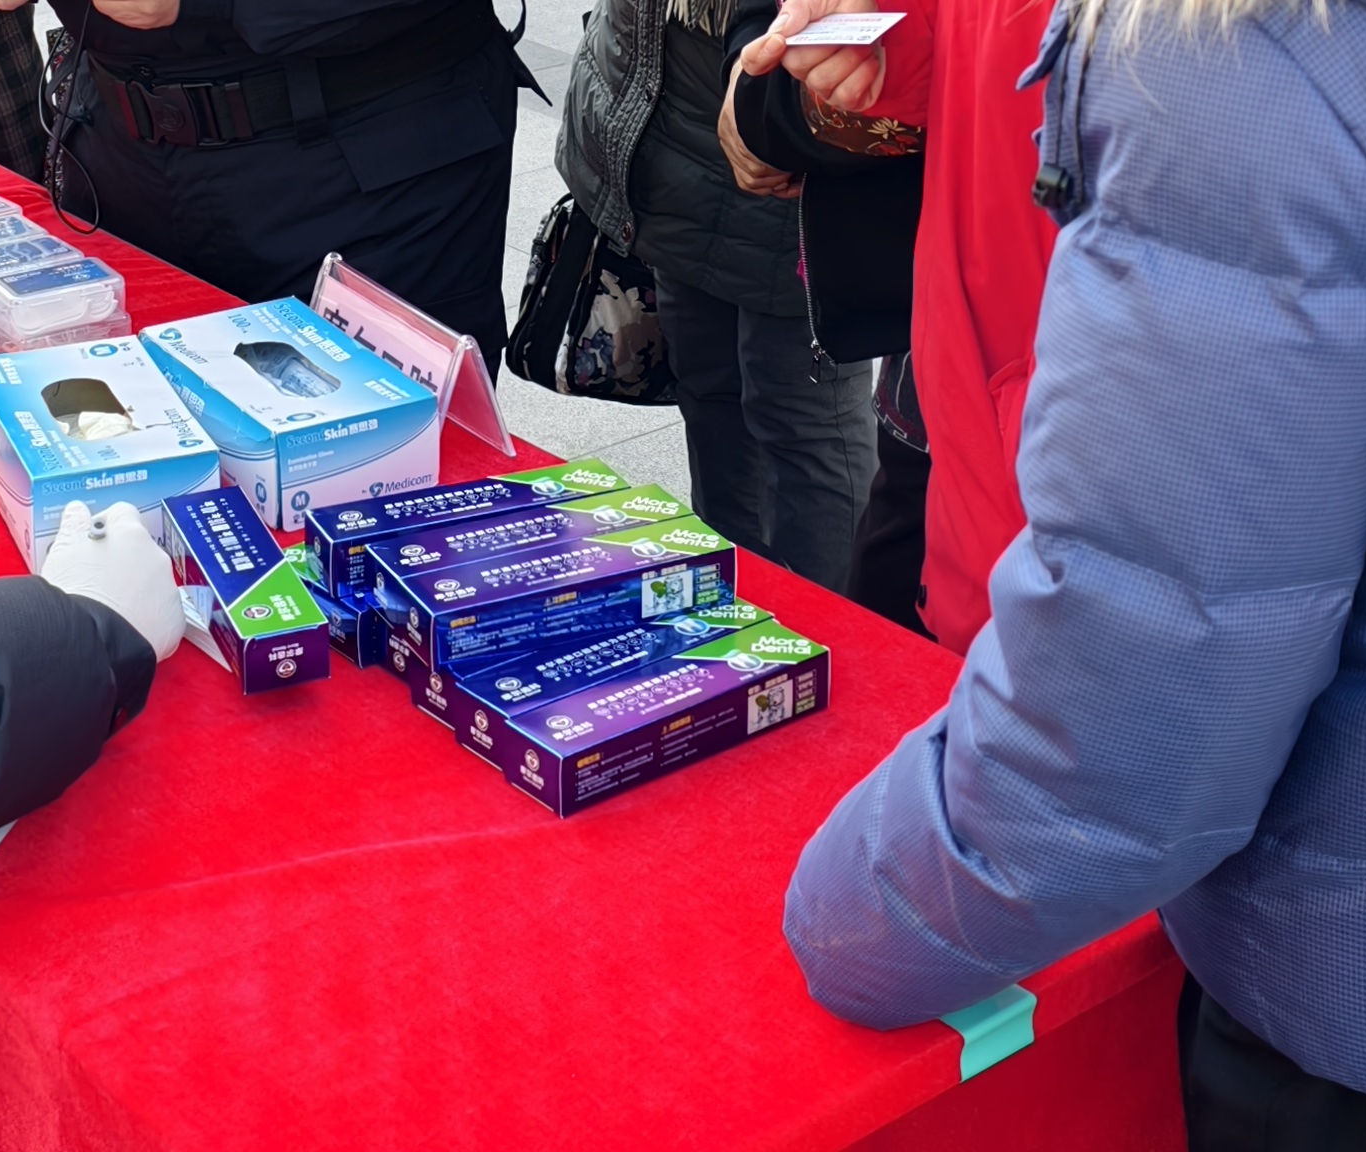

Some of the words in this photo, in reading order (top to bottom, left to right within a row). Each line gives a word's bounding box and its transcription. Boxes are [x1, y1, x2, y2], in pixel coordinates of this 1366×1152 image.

[286, 422, 348, 448] SecondSkin
[561, 473, 617, 488] Dental
[572, 468, 619, 481] More
[42, 472, 113, 496] SecondSkin
[386, 475, 432, 494] Medicom
[295, 493, 306, 508] M
[633, 496, 680, 508] More
[622, 501, 679, 515] Dental
[661, 533, 719, 549] Dental
[671, 528, 719, 540] More
[698, 609, 757, 620] Dental
[758, 636, 810, 647] More
[751, 643, 812, 655] Dental
